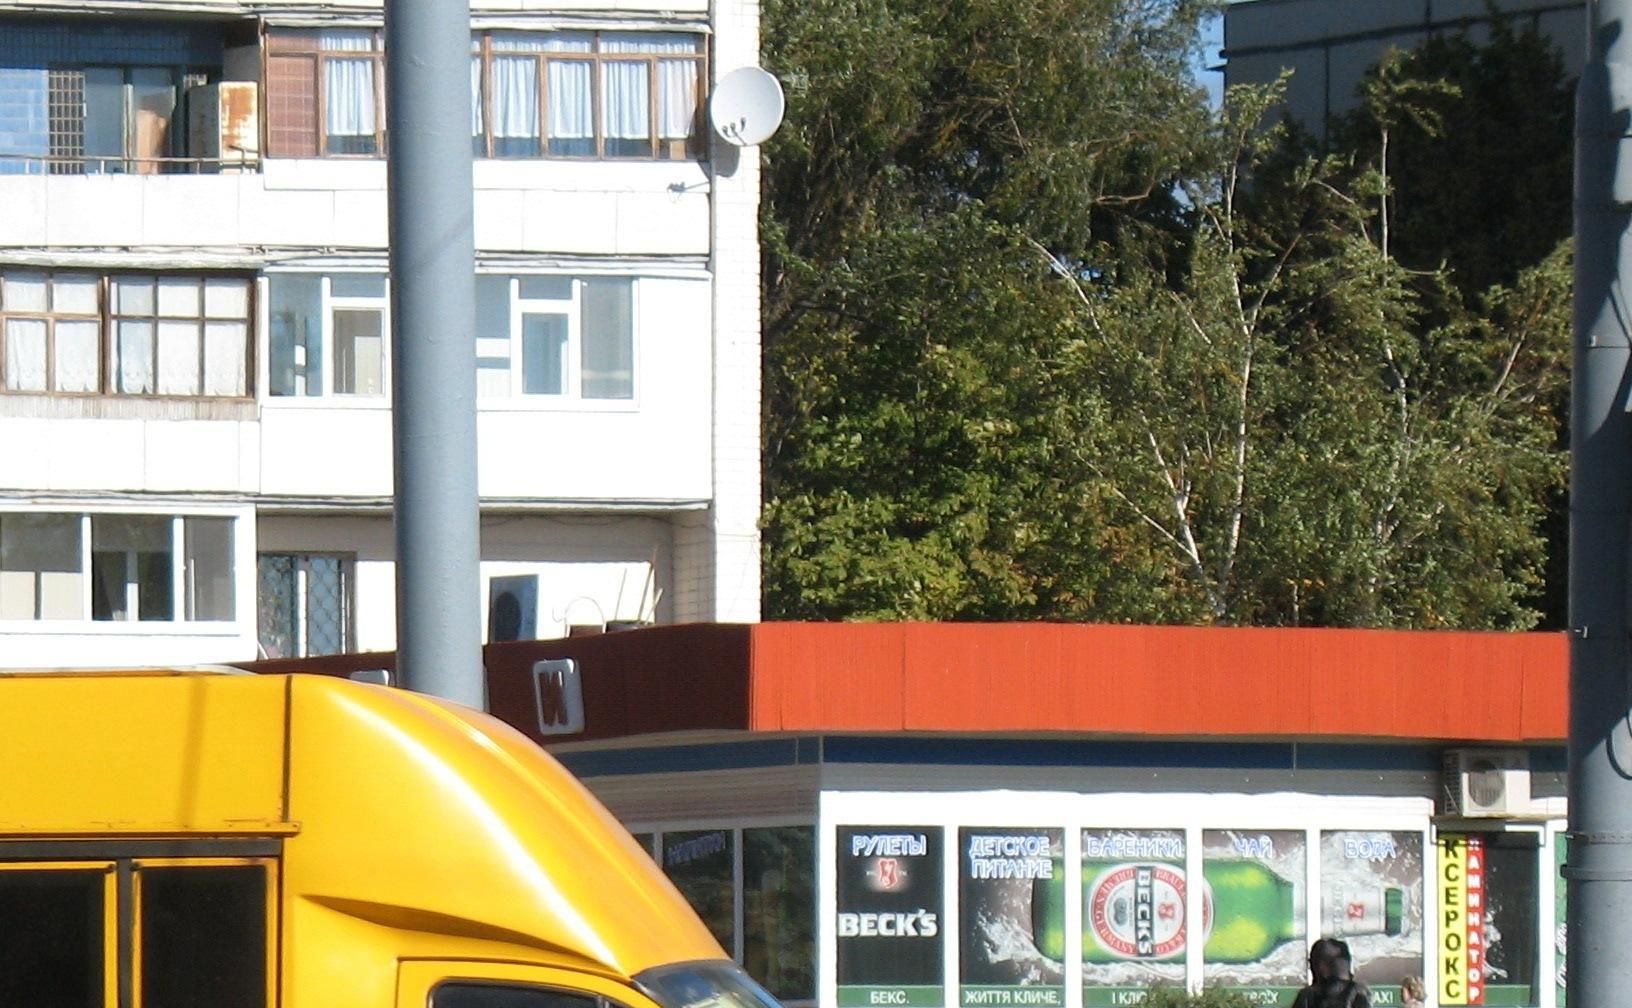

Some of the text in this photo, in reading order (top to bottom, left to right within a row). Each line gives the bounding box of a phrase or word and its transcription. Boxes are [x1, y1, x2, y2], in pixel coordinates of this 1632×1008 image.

[852, 834, 927, 856] РУЛЕТЫ
[968, 835, 1051, 858] ДЕТСКОЕ
[1087, 835, 1183, 858] ВАРЕНИКИ
[1235, 834, 1274, 859] ЧАЙ
[1343, 838, 1397, 862] ВОДА
[971, 858, 1053, 880] ПИТАНИЕ
[839, 907, 938, 937] BECK'S
[1444, 839, 1461, 999] КСЕРОКС
[870, 990, 910, 1004] БЕКС.
[965, 990, 1061, 1006] ЖИТТЯ КЛИЧЕ,
